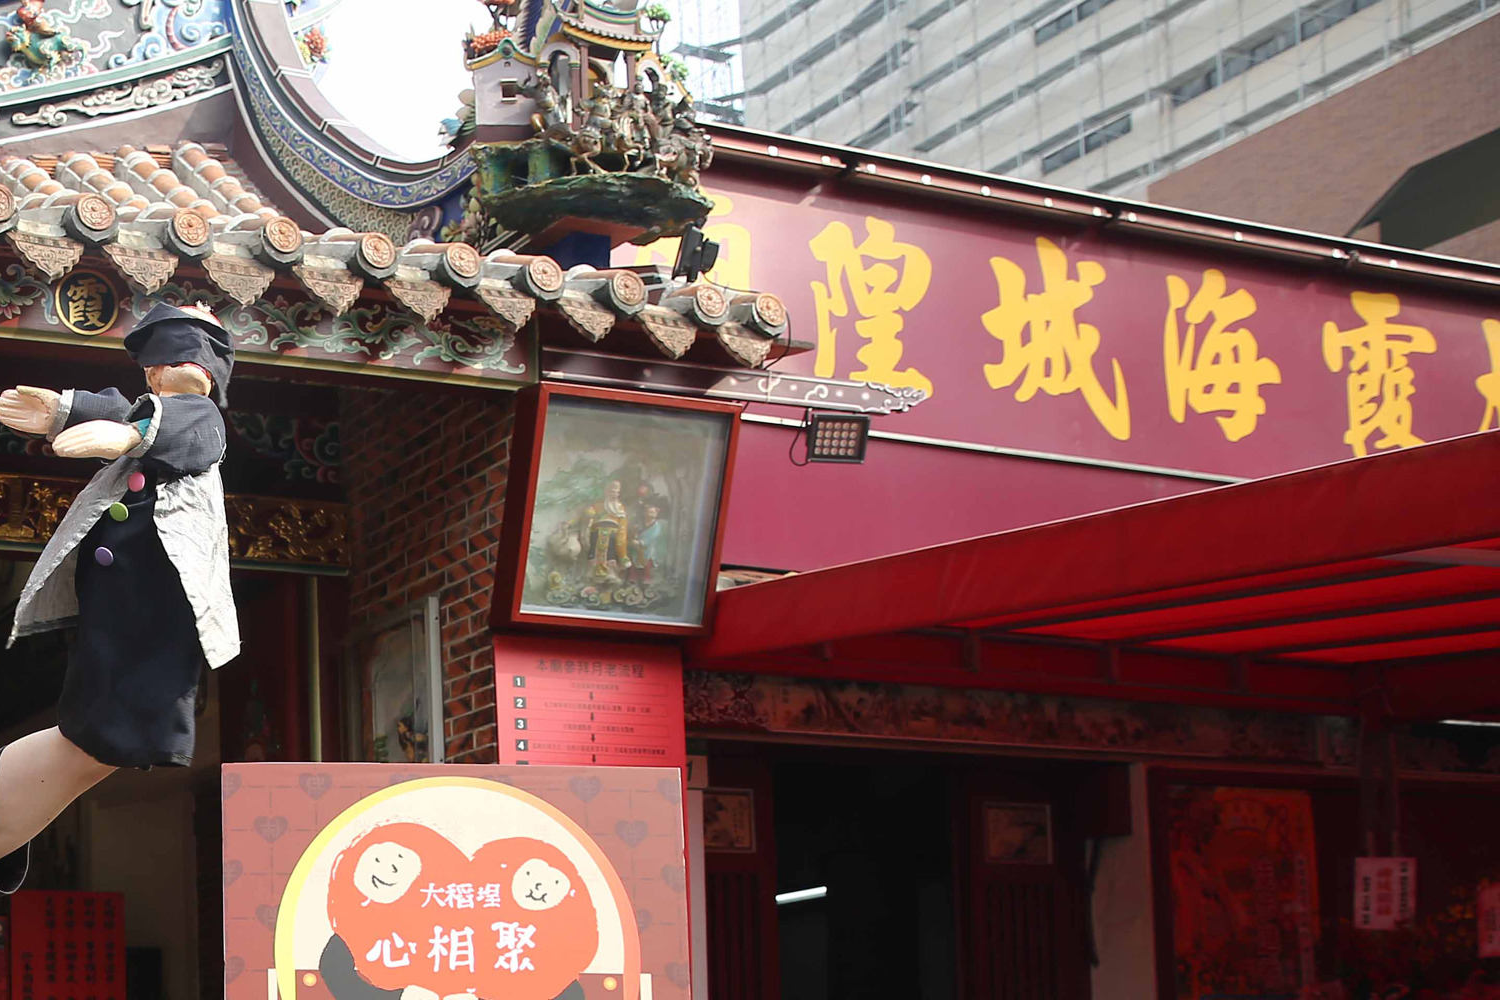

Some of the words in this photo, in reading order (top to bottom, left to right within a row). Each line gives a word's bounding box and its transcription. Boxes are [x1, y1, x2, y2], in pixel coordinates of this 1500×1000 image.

[67, 285, 107, 330] 霞
[515, 677, 522, 687] 1
[516, 698, 524, 708] 2
[517, 719, 524, 729] 3
[517, 740, 525, 750] 4
[420, 882, 501, 909] 大稻埕
[366, 921, 537, 973] 心相聚
